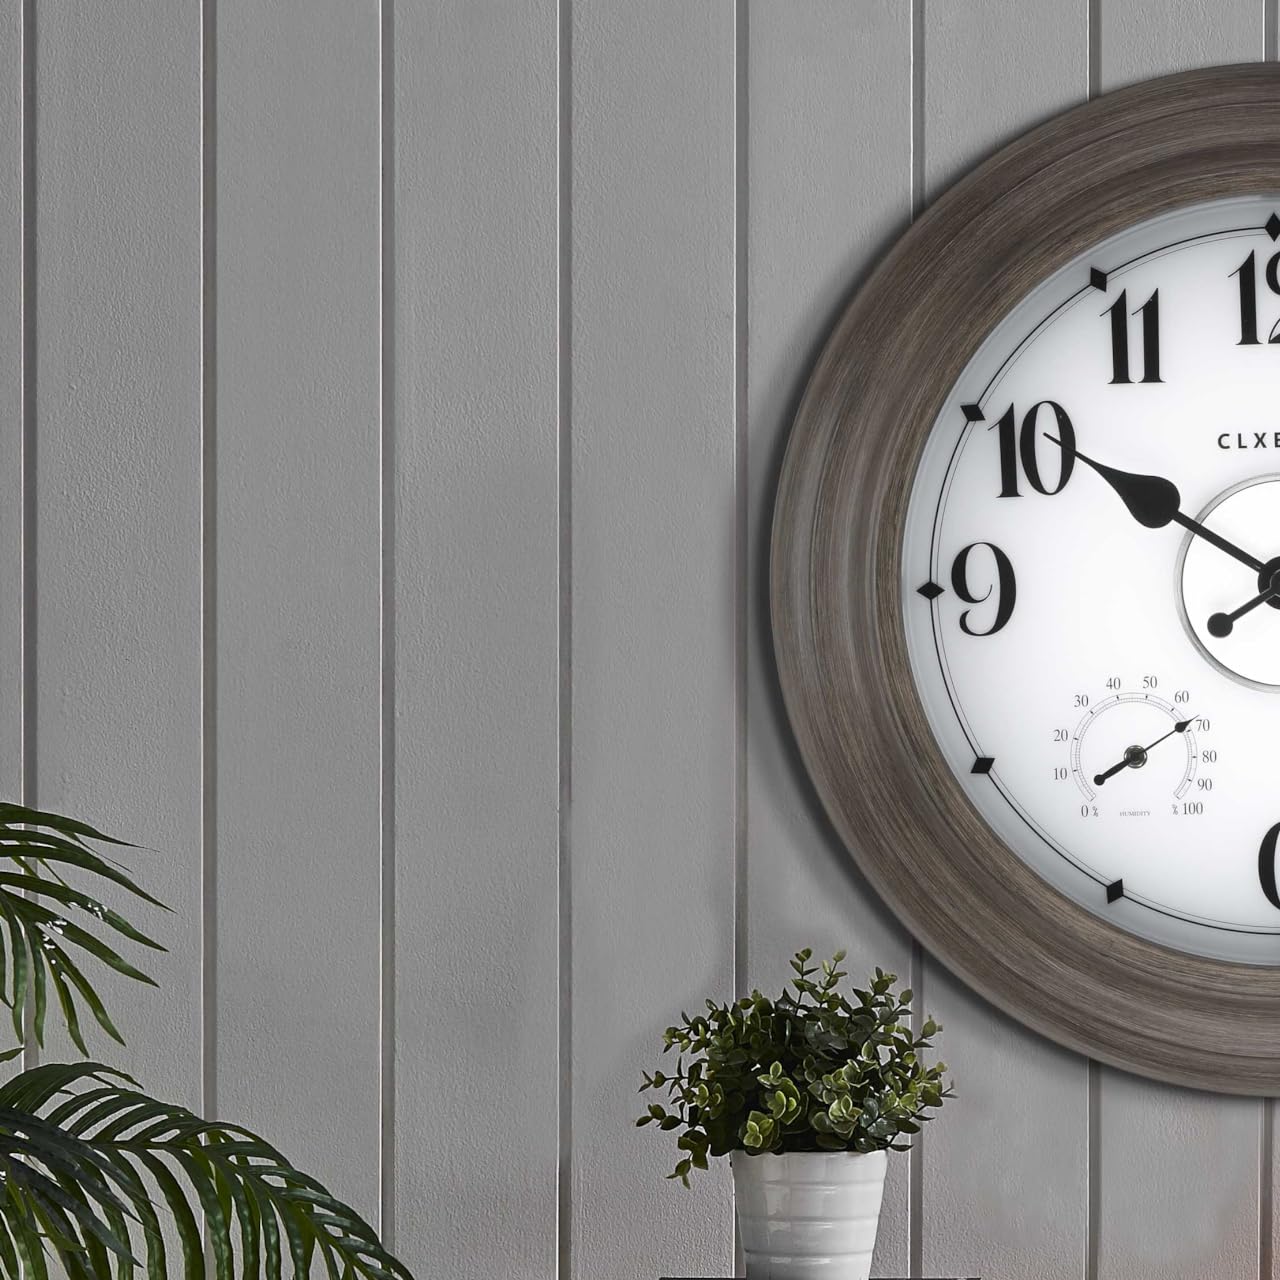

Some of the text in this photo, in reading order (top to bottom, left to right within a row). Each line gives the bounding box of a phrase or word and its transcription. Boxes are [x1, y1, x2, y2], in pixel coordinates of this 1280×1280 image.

[1099, 286, 1164, 385] 11
[987, 400, 1077, 499] 10
[950, 541, 1018, 638] 9
[1106, 677, 1121, 690] 40
[1142, 675, 1158, 689] 50
[1073, 694, 1089, 708] 30
[1174, 690, 1189, 704] 60
[1195, 718, 1210, 732] 70
[1053, 728, 1068, 742] 20
[1202, 750, 1217, 764] 80
[1054, 767, 1068, 781] 10
[1197, 778, 1213, 791] 90
[1081, 805, 1089, 818] 0
[1182, 802, 1204, 815] 100
